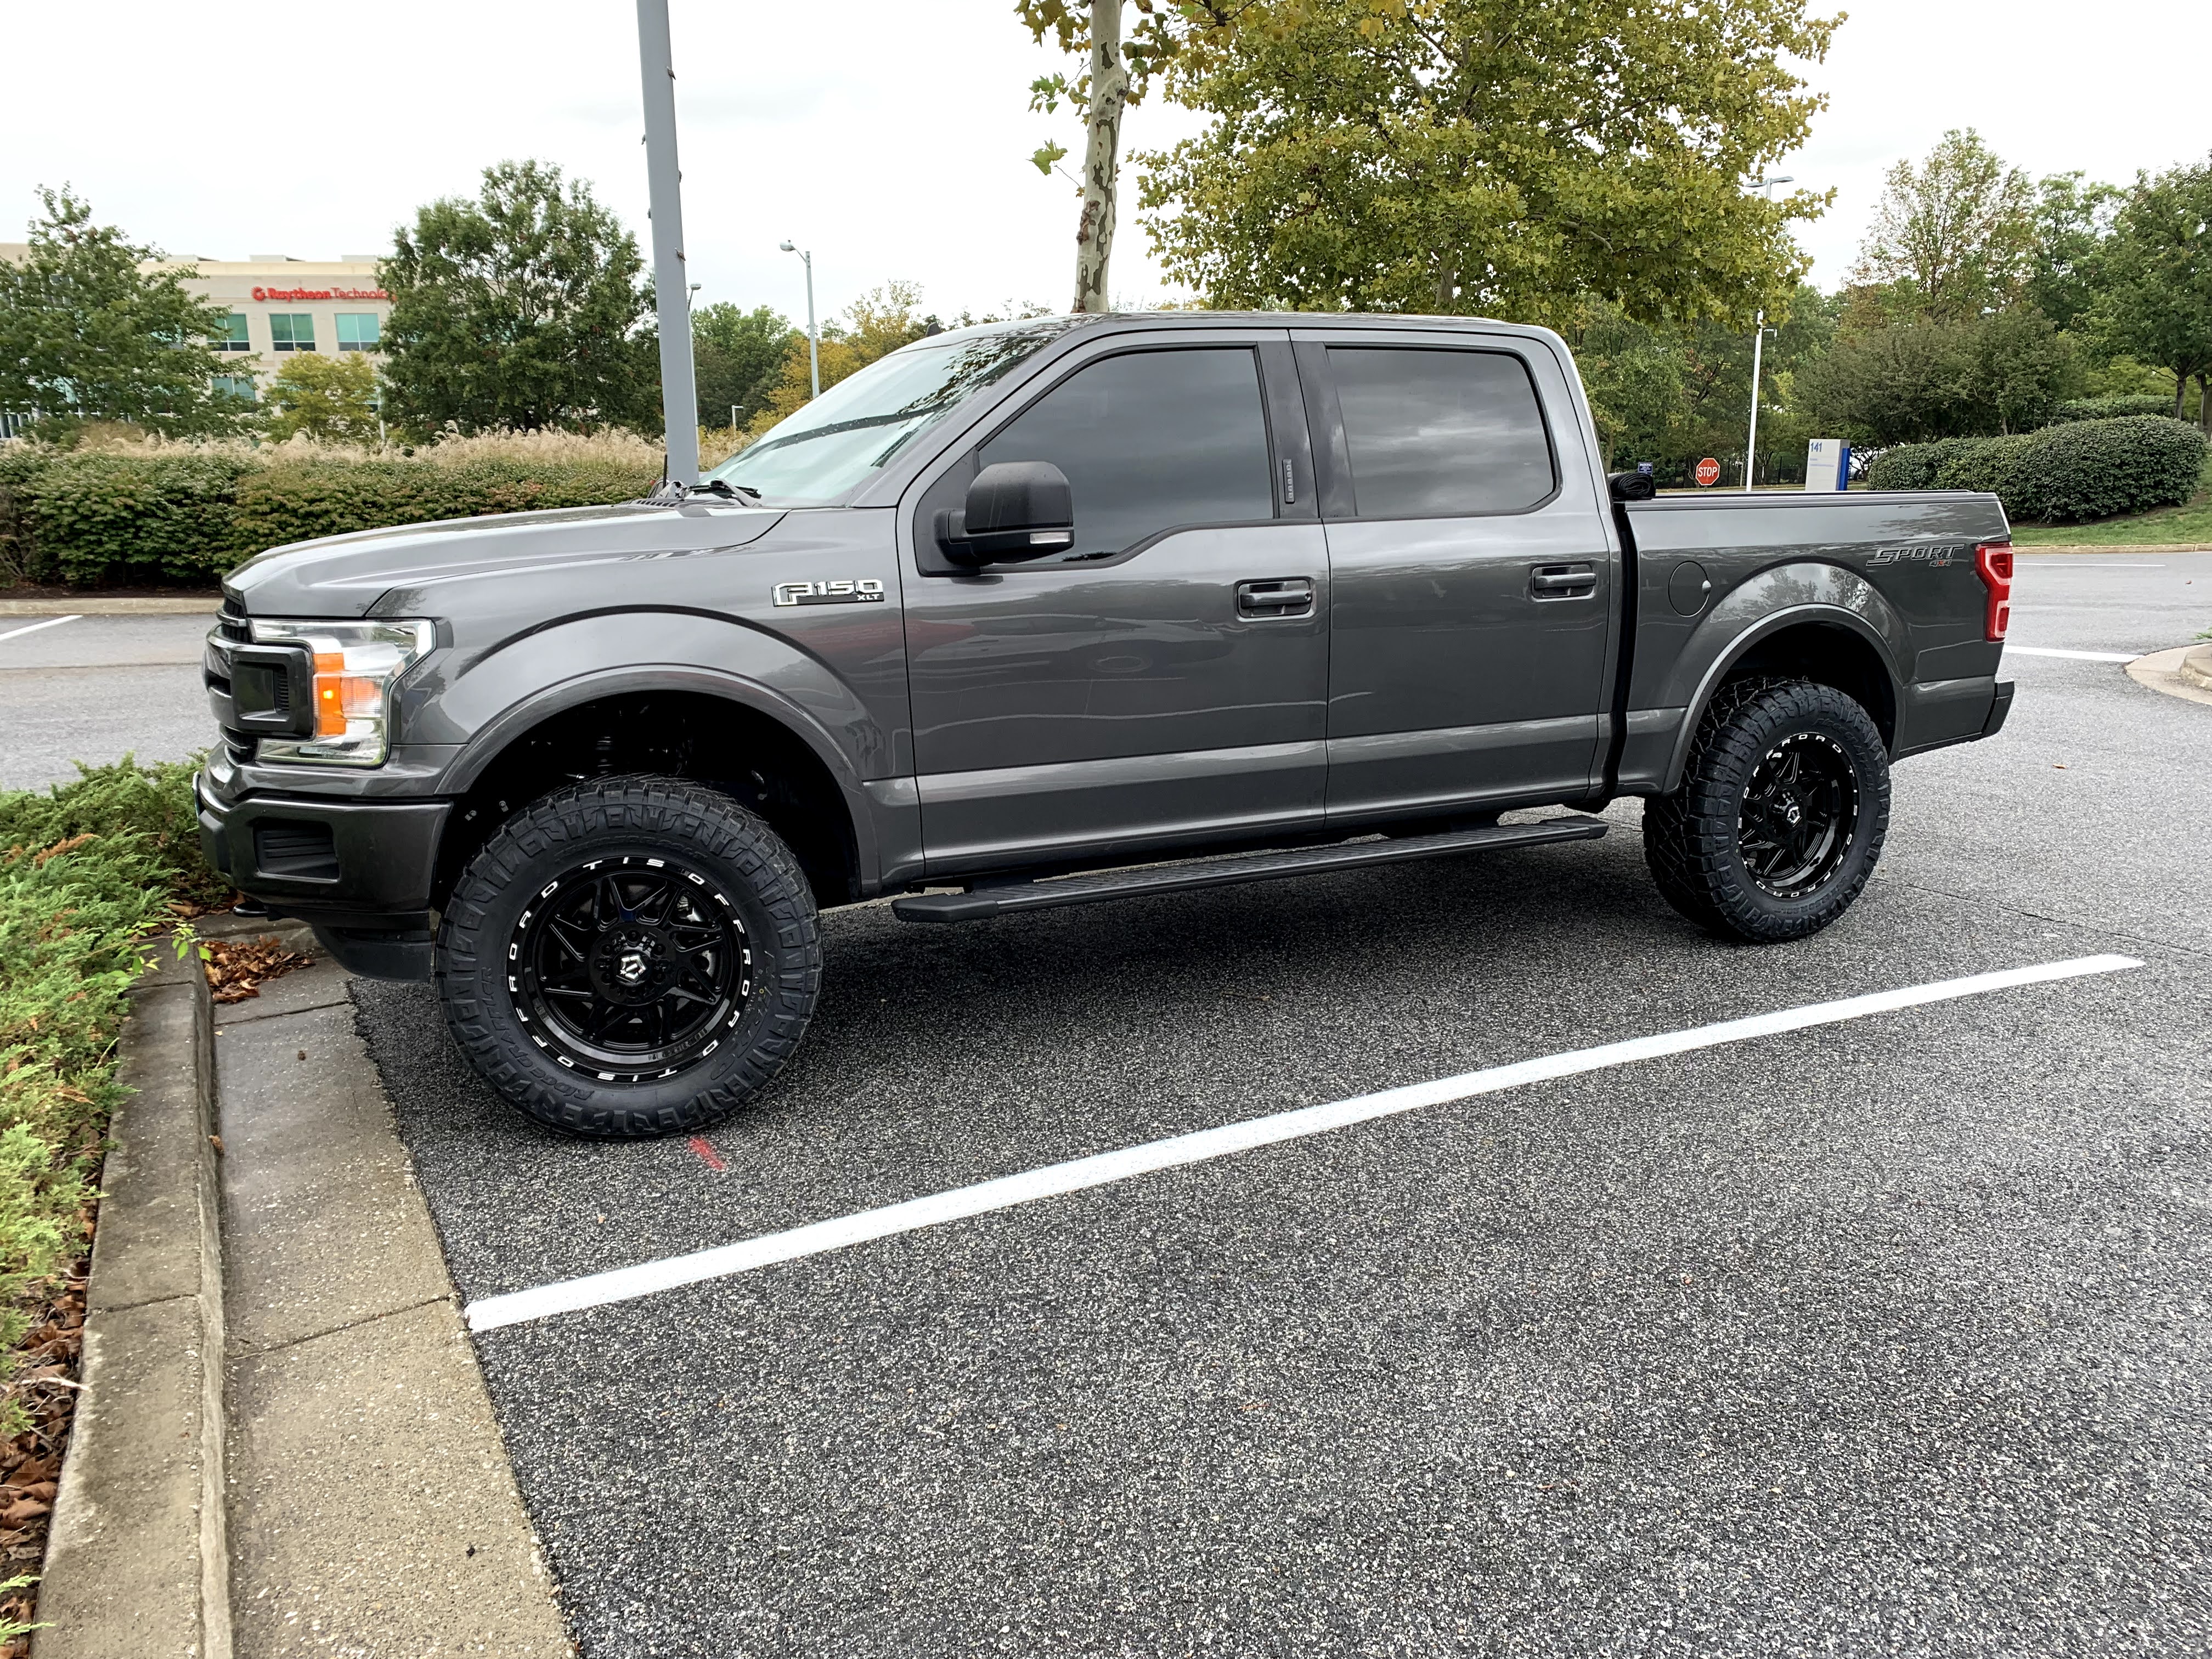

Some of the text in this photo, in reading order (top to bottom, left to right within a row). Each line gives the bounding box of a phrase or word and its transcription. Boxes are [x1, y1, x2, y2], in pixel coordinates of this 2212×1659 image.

[267, 287, 397, 302] Raytheon Technolo
[1810, 442, 1822, 453] 141
[1698, 466, 1718, 477] STOP
[1866, 544, 1965, 566] SPORT
[772, 579, 883, 607] F150
[583, 856, 665, 870] TIS
[597, 1069, 678, 1082] TIS
